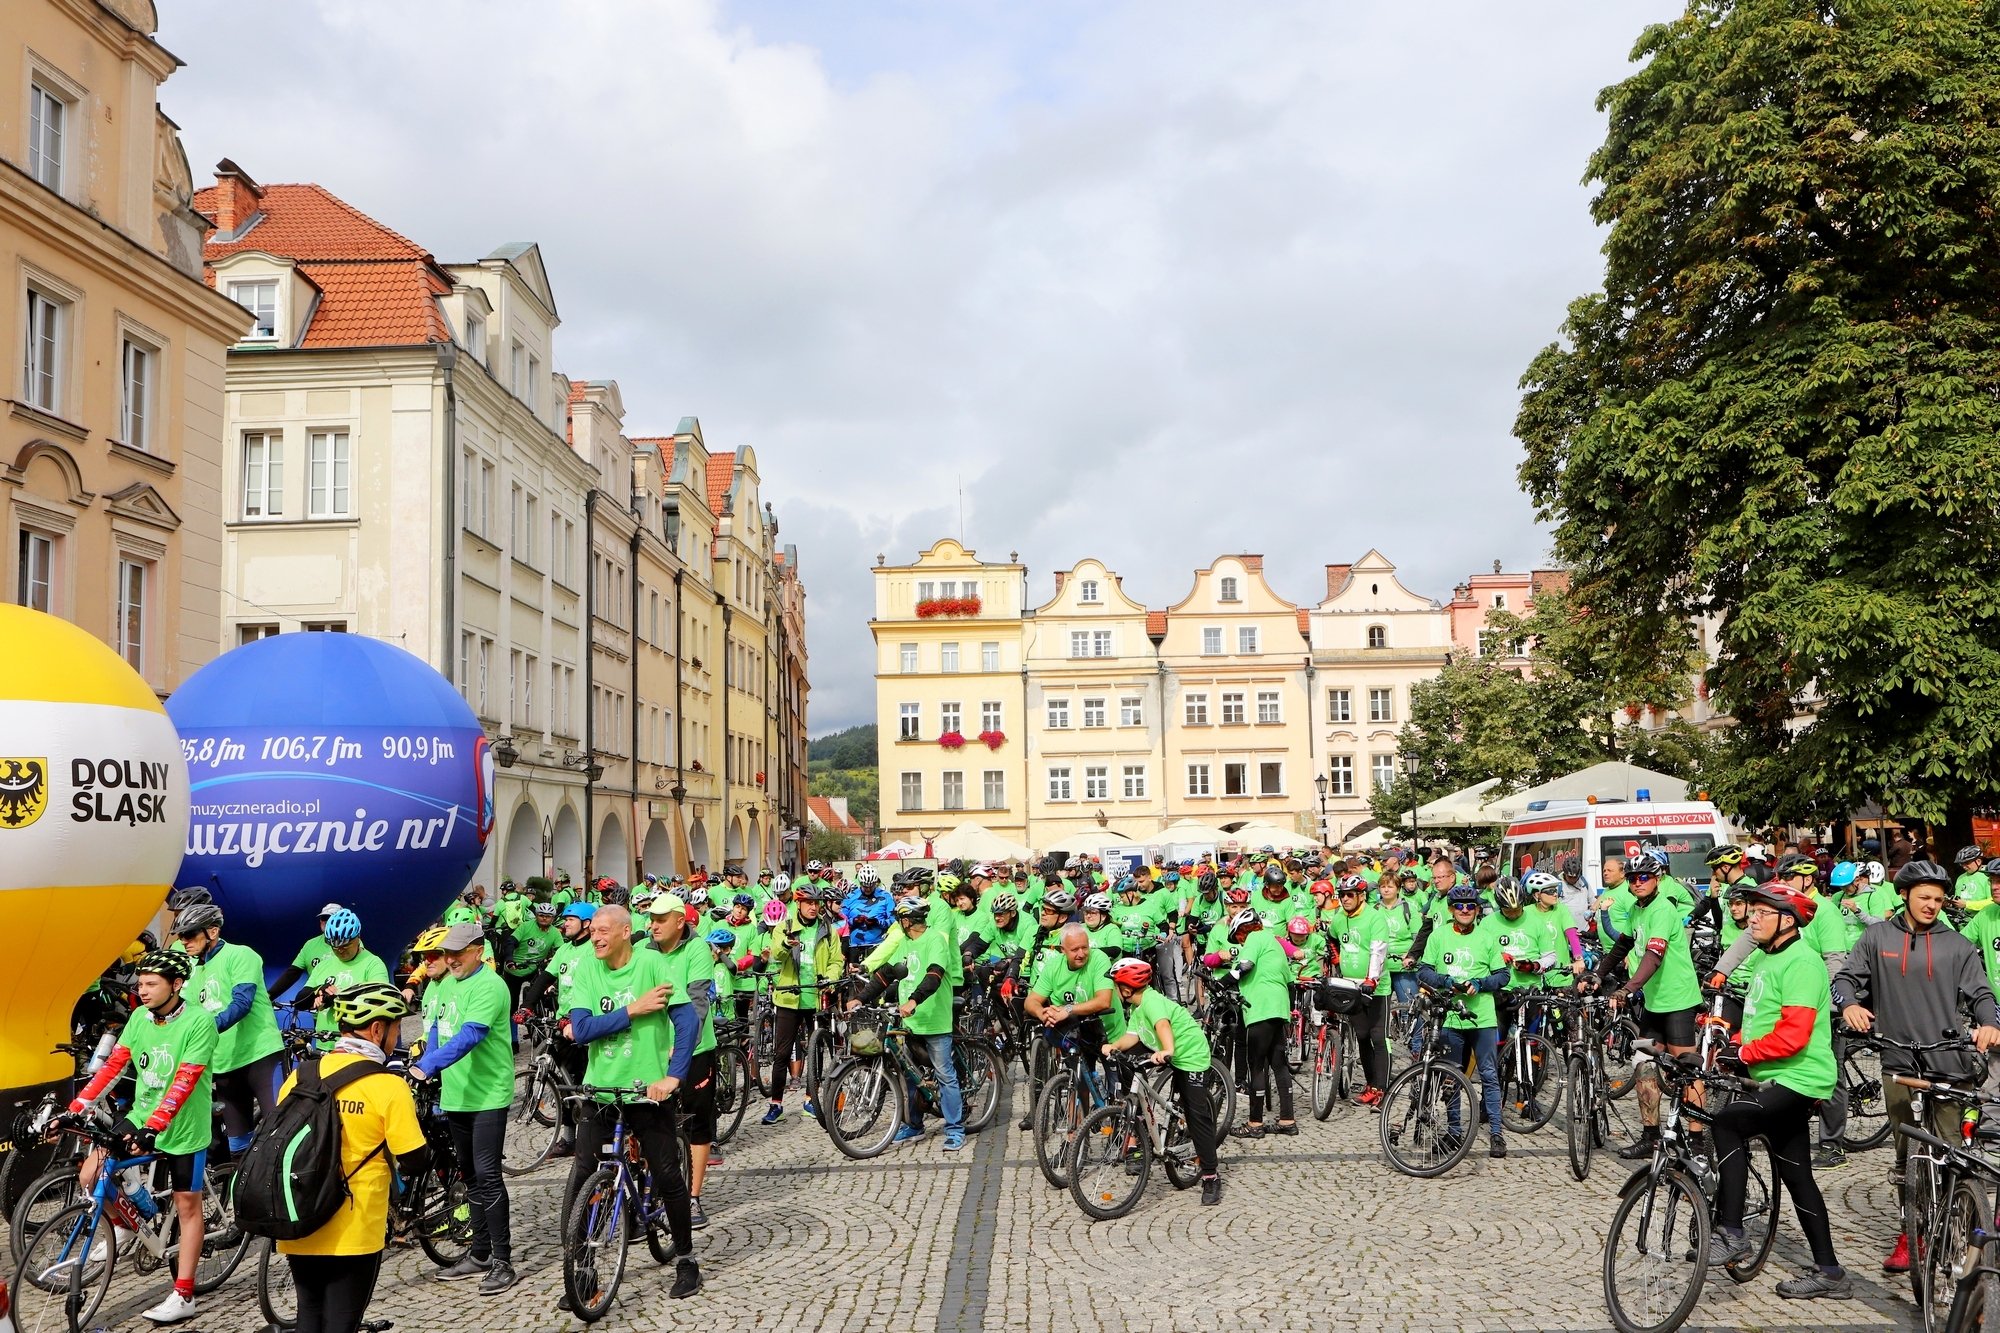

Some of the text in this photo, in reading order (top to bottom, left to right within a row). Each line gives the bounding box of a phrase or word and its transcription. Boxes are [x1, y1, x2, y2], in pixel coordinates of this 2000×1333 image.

[210, 737, 246, 768] fm
[261, 736, 327, 762] 106,7
[326, 736, 363, 766] fm
[382, 736, 428, 762] 90,9
[429, 736, 455, 766] fm
[71, 758, 169, 790] DOLNY
[70, 785, 167, 827] ŚLĄSK
[1596, 813, 1712, 826] TRANSPORT MEDYCZNY
[1444, 954, 1452, 963] 21
[602, 1000, 612, 1010] 21
[140, 1054, 148, 1067] 21
